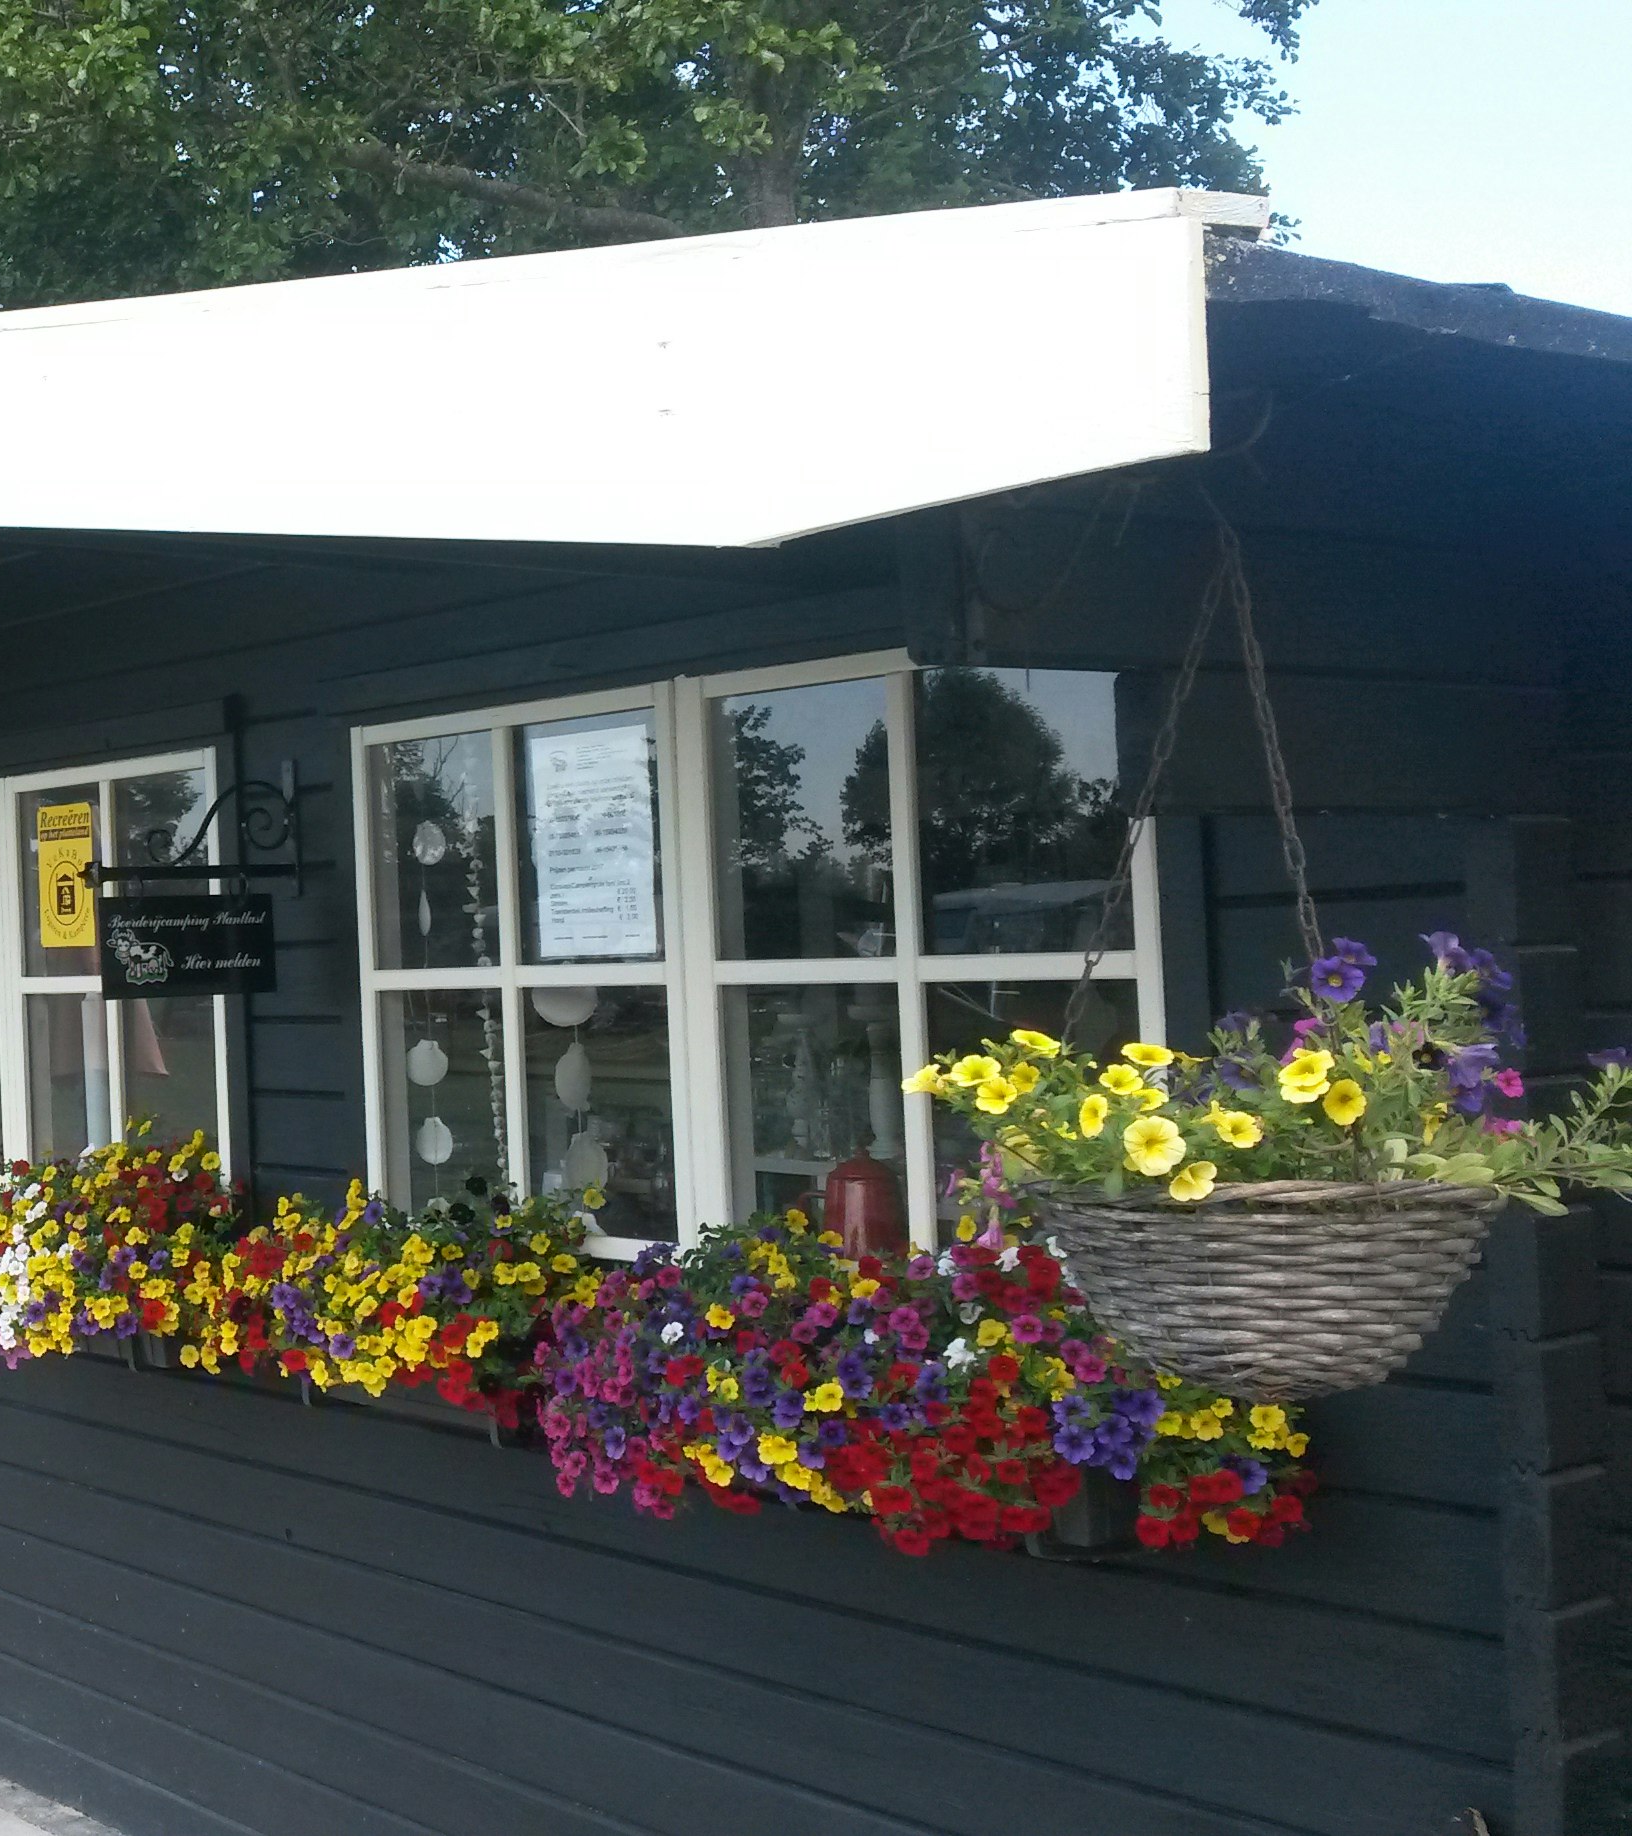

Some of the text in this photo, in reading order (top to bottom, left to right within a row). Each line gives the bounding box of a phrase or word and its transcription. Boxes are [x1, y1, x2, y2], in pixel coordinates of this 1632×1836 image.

[40, 809, 89, 828] Recreëren
[108, 914, 210, 933] Boerderijcamping
[180, 952, 261, 970] Hier melden
